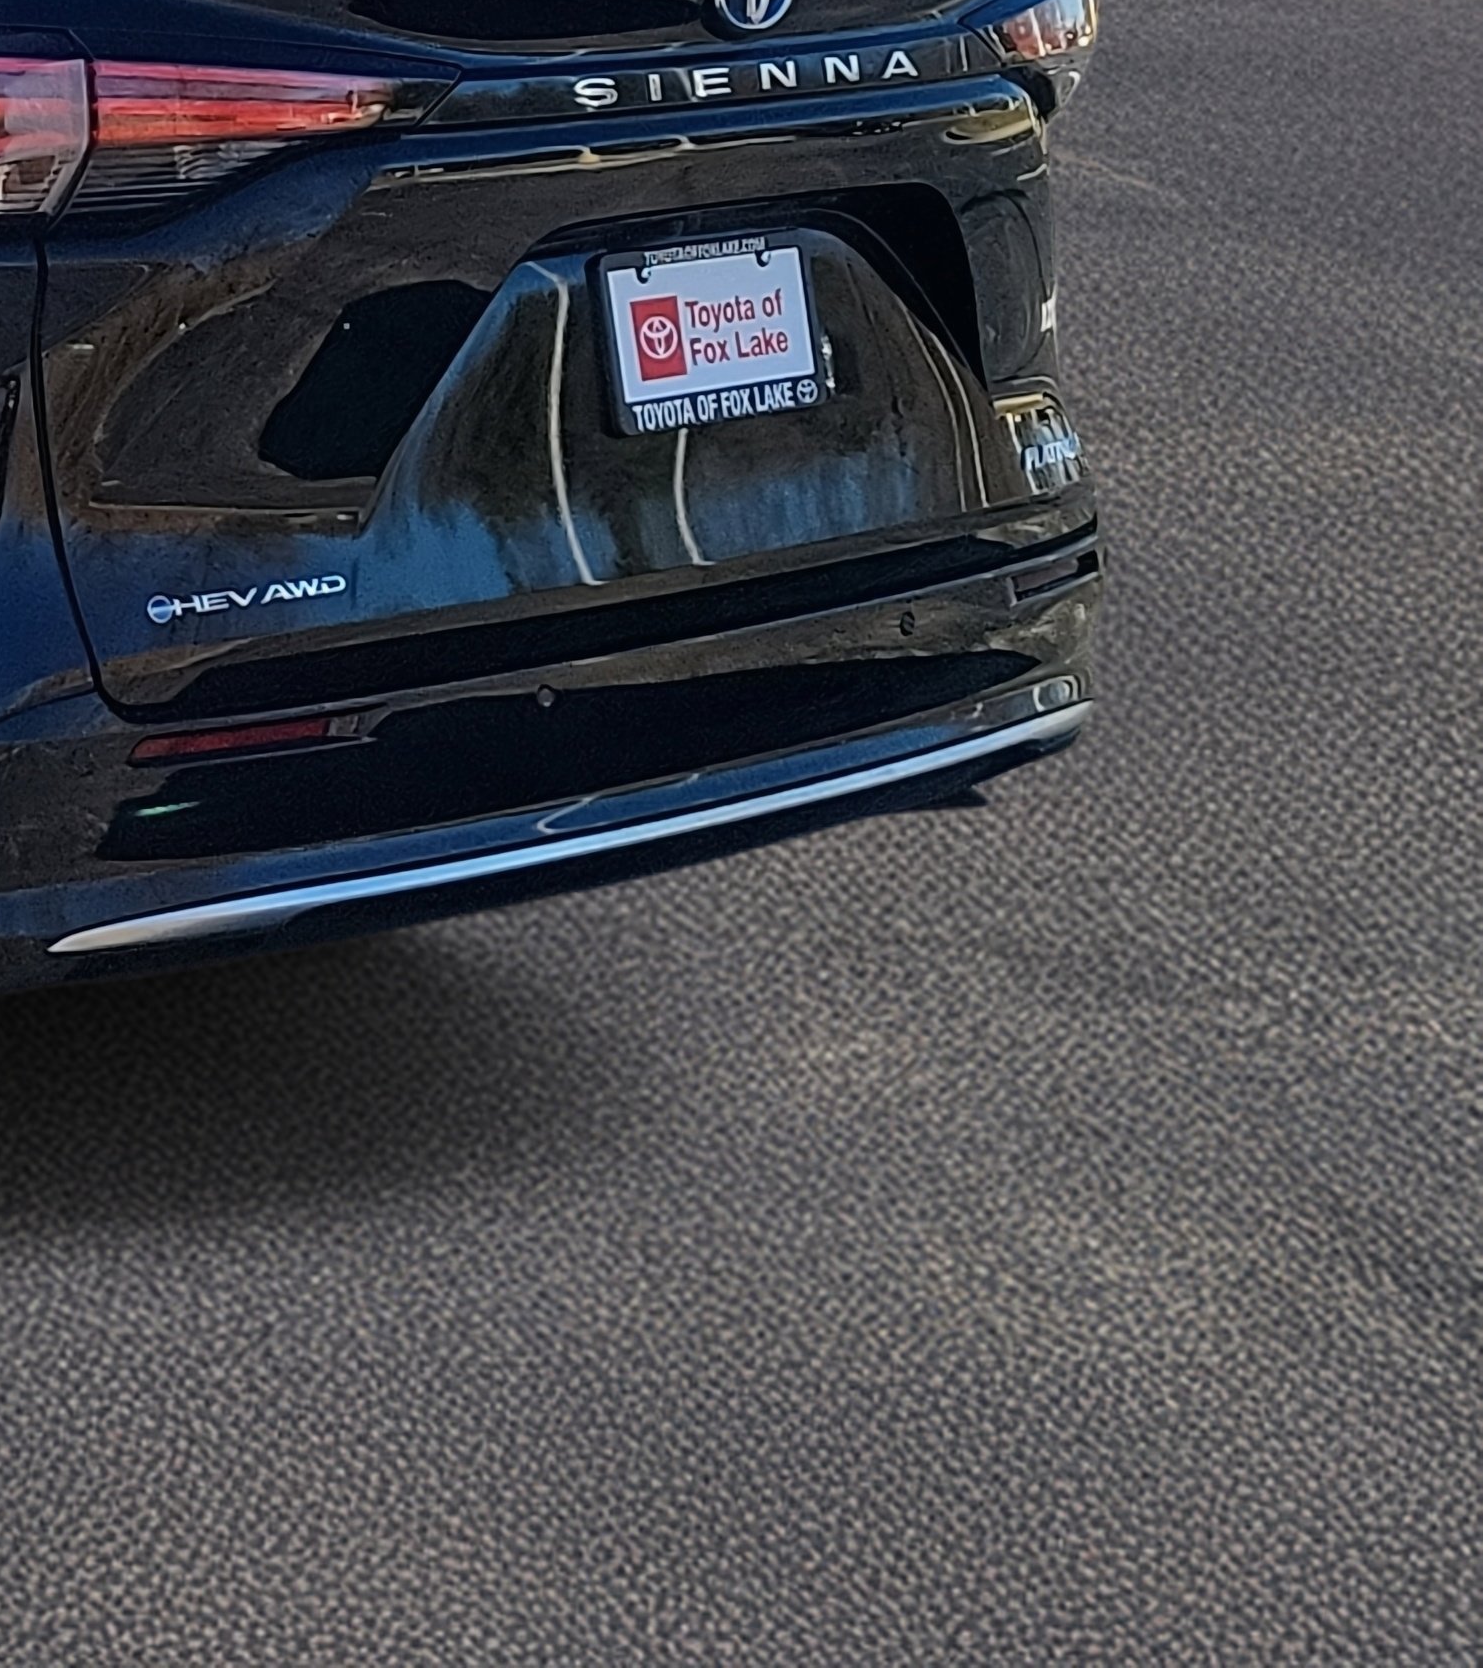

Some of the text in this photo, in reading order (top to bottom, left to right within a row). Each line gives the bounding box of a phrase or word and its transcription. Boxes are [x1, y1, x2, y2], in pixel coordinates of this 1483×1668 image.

[574, 50, 919, 107] SIENNA
[684, 287, 782, 333] Toyota of
[689, 327, 788, 366] Fox Lake
[632, 381, 796, 432] TOYOTA OF FOX LAKE
[260, 575, 347, 605] AWD
